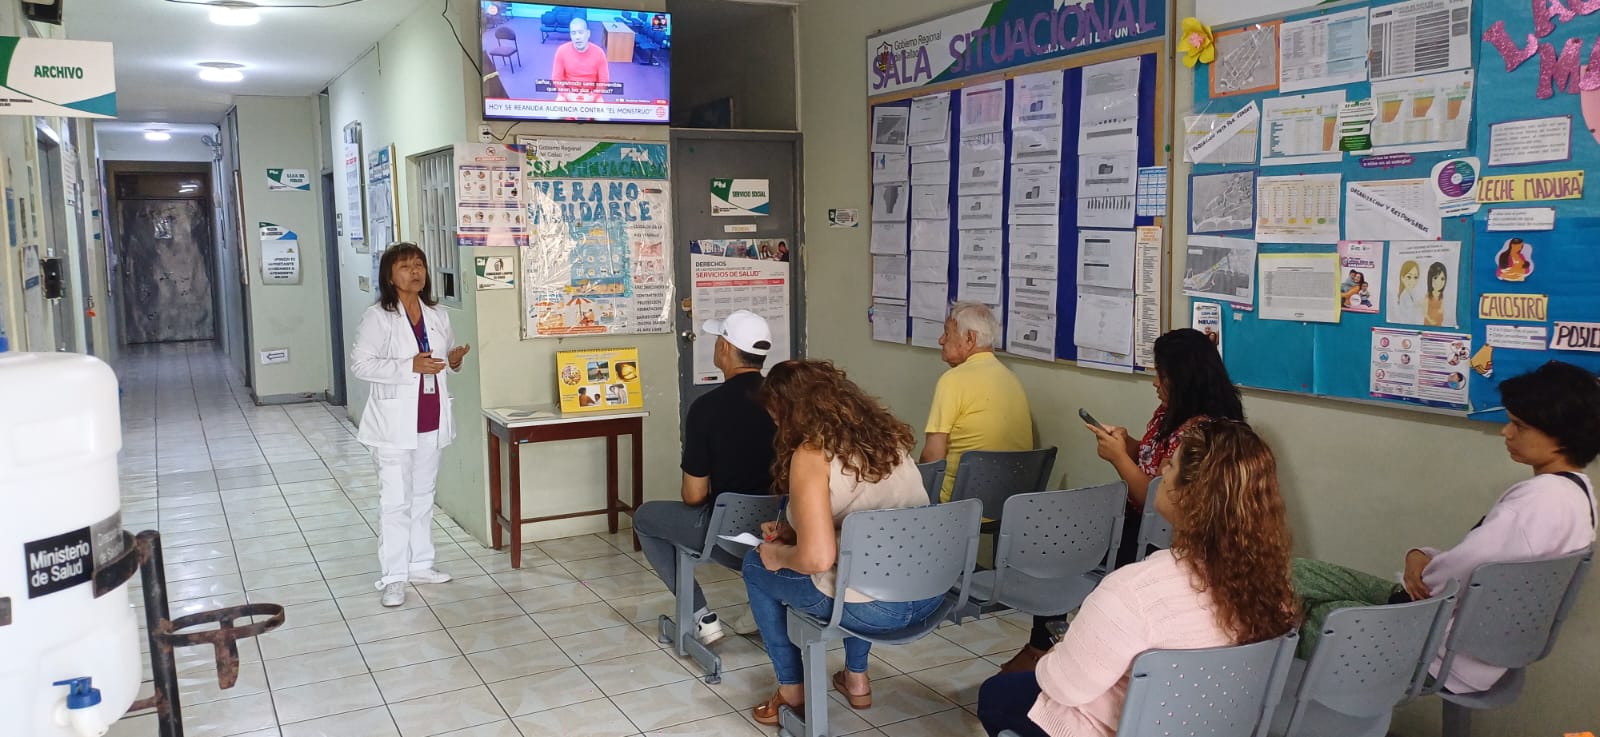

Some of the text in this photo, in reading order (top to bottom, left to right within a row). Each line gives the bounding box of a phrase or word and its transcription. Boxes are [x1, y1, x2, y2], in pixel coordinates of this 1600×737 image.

[872, 45, 932, 90] SALA
[949, 0, 1157, 74] SITUACIONAL
[34, 65, 84, 80] ARCHIVO
[534, 180, 639, 202] VERANO
[1478, 179, 1515, 201] LECHE
[1524, 176, 1582, 200] MADURA
[1481, 296, 1545, 320] CALOSTRO
[30, 540, 91, 571] Ministerio
[31, 559, 84, 588] de Salud
